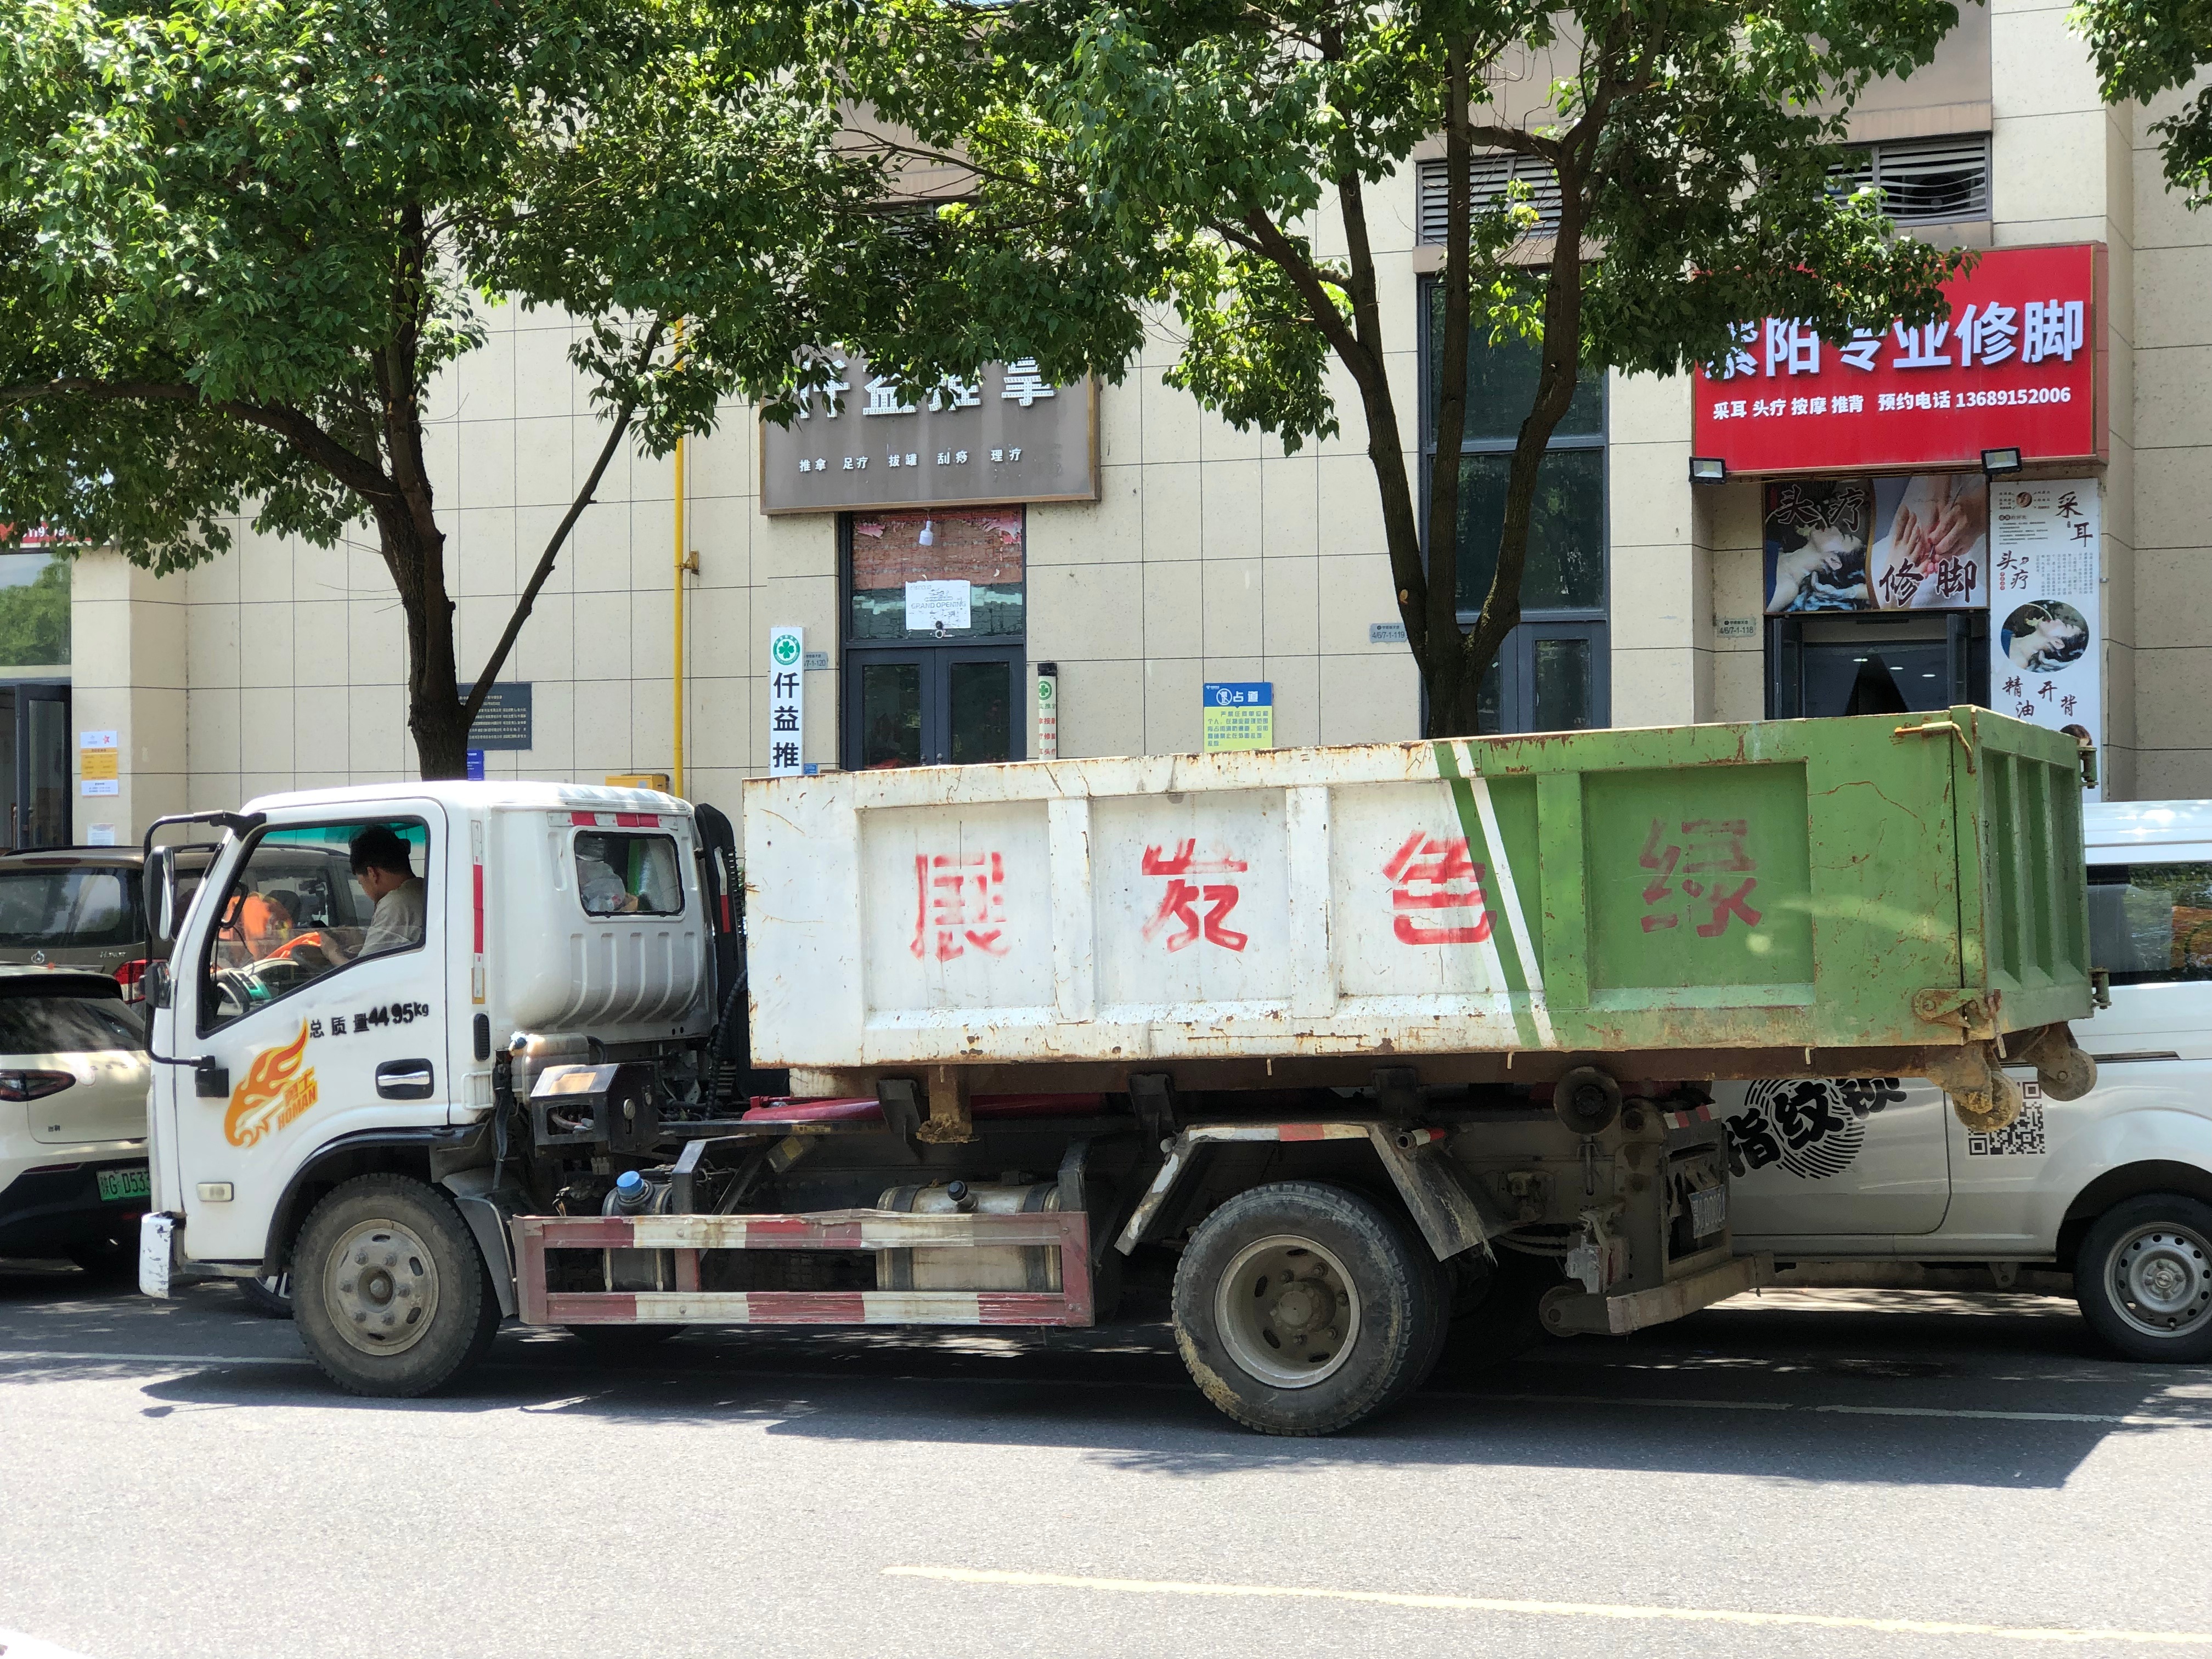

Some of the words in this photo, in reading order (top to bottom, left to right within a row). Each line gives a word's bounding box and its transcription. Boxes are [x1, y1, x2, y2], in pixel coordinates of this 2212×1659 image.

[1713, 399, 1747, 420] 采耳
[1753, 398, 1785, 418] 头疗
[1791, 396, 1826, 415] 按摩
[1832, 395, 1864, 414] 推背
[1878, 391, 1951, 412] 预约电话
[1956, 387, 2071, 408] 13689152006
[799, 458, 826, 472] 推拿
[843, 456, 868, 470] 足疗
[889, 453, 917, 467] 拔罐
[938, 450, 968, 465] 刮痧
[991, 448, 1022, 462] 理疗
[1775, 485, 1865, 531] 头疗
[1879, 557, 1978, 606] 修脚
[1997, 550, 2029, 589] 头疗
[773, 672, 799, 768] 仟益推
[278, 1086, 316, 1130] HOMAN
